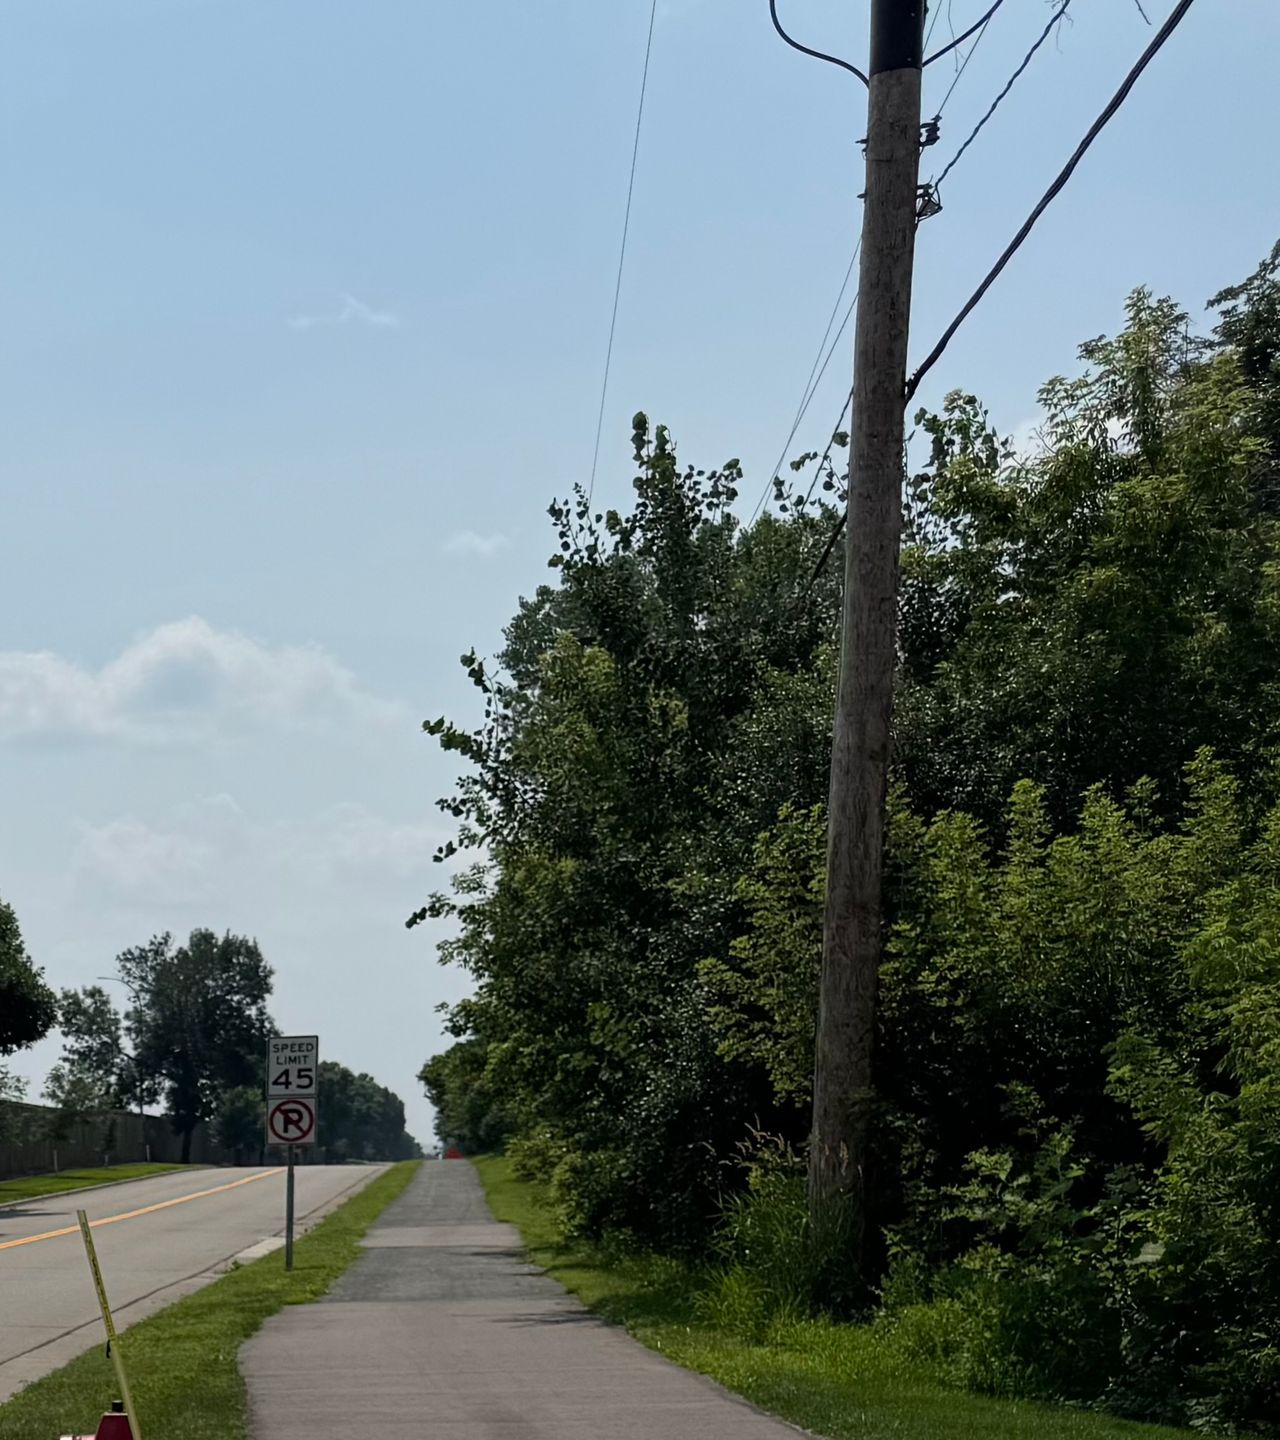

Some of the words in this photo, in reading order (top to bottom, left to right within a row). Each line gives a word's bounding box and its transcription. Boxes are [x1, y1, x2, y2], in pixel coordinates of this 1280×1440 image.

[273, 1043, 314, 1053] SPEED
[276, 1055, 309, 1065] LIMIT
[271, 1068, 314, 1089] 45
